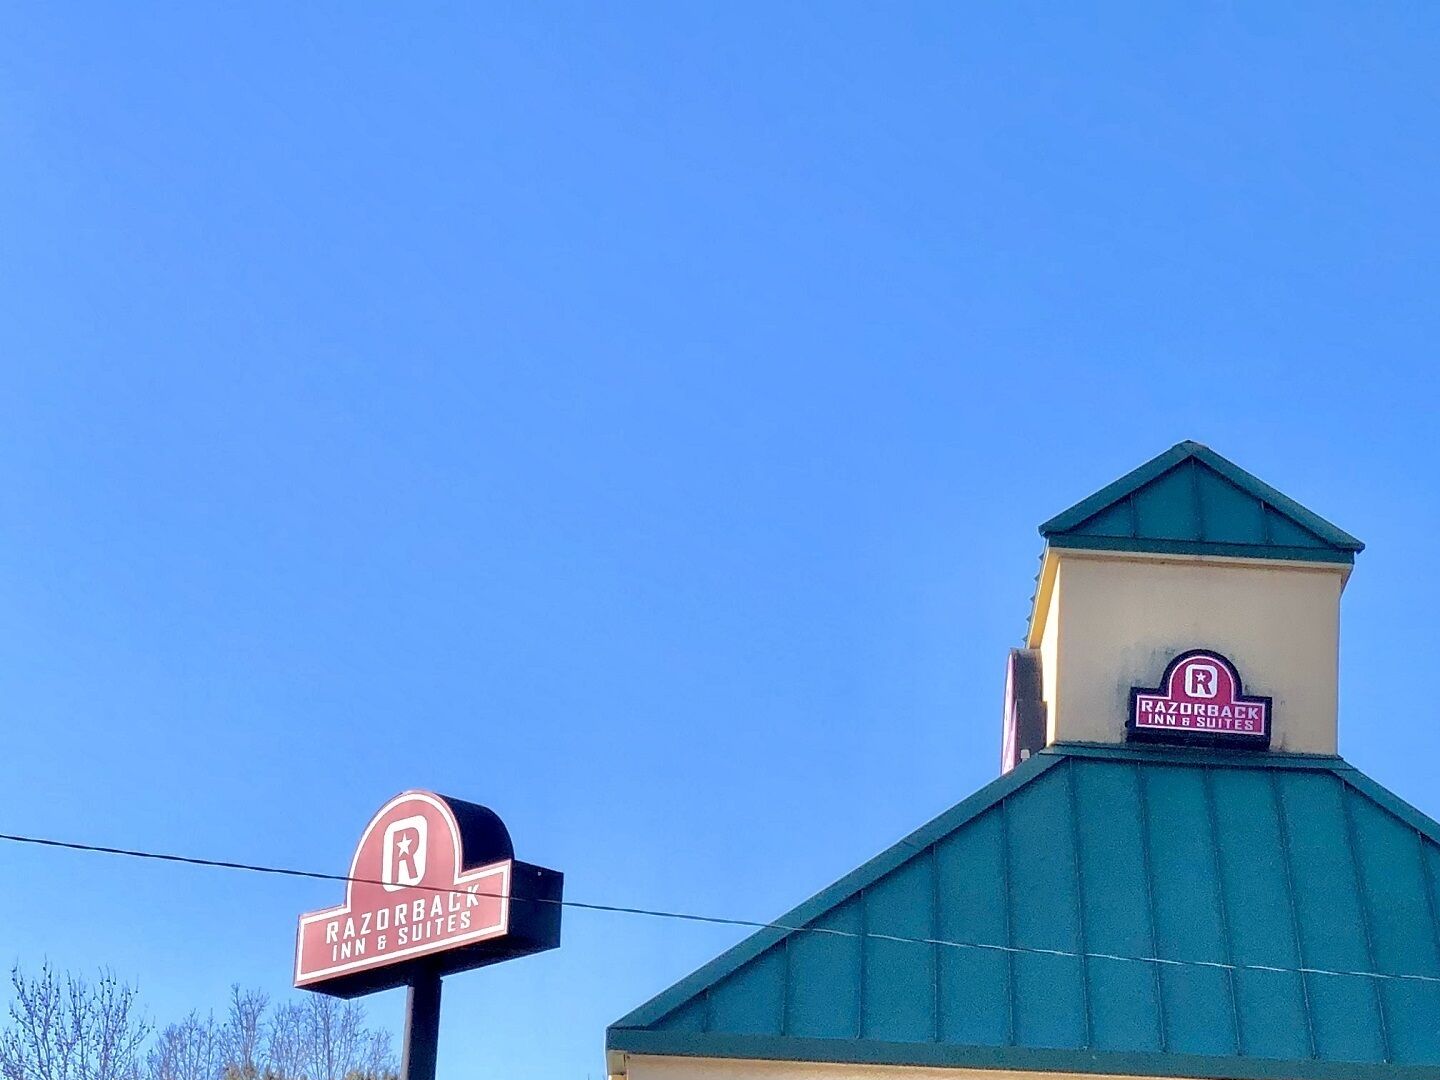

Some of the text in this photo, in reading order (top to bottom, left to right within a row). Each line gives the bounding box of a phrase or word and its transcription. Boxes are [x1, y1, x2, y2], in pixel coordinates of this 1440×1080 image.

[1141, 700, 1259, 720] RAZORBACK
[1148, 713, 1255, 731] INN & SUITES
[326, 884, 480, 944] RAZORBACK
[332, 911, 472, 962] INN & SUITES
